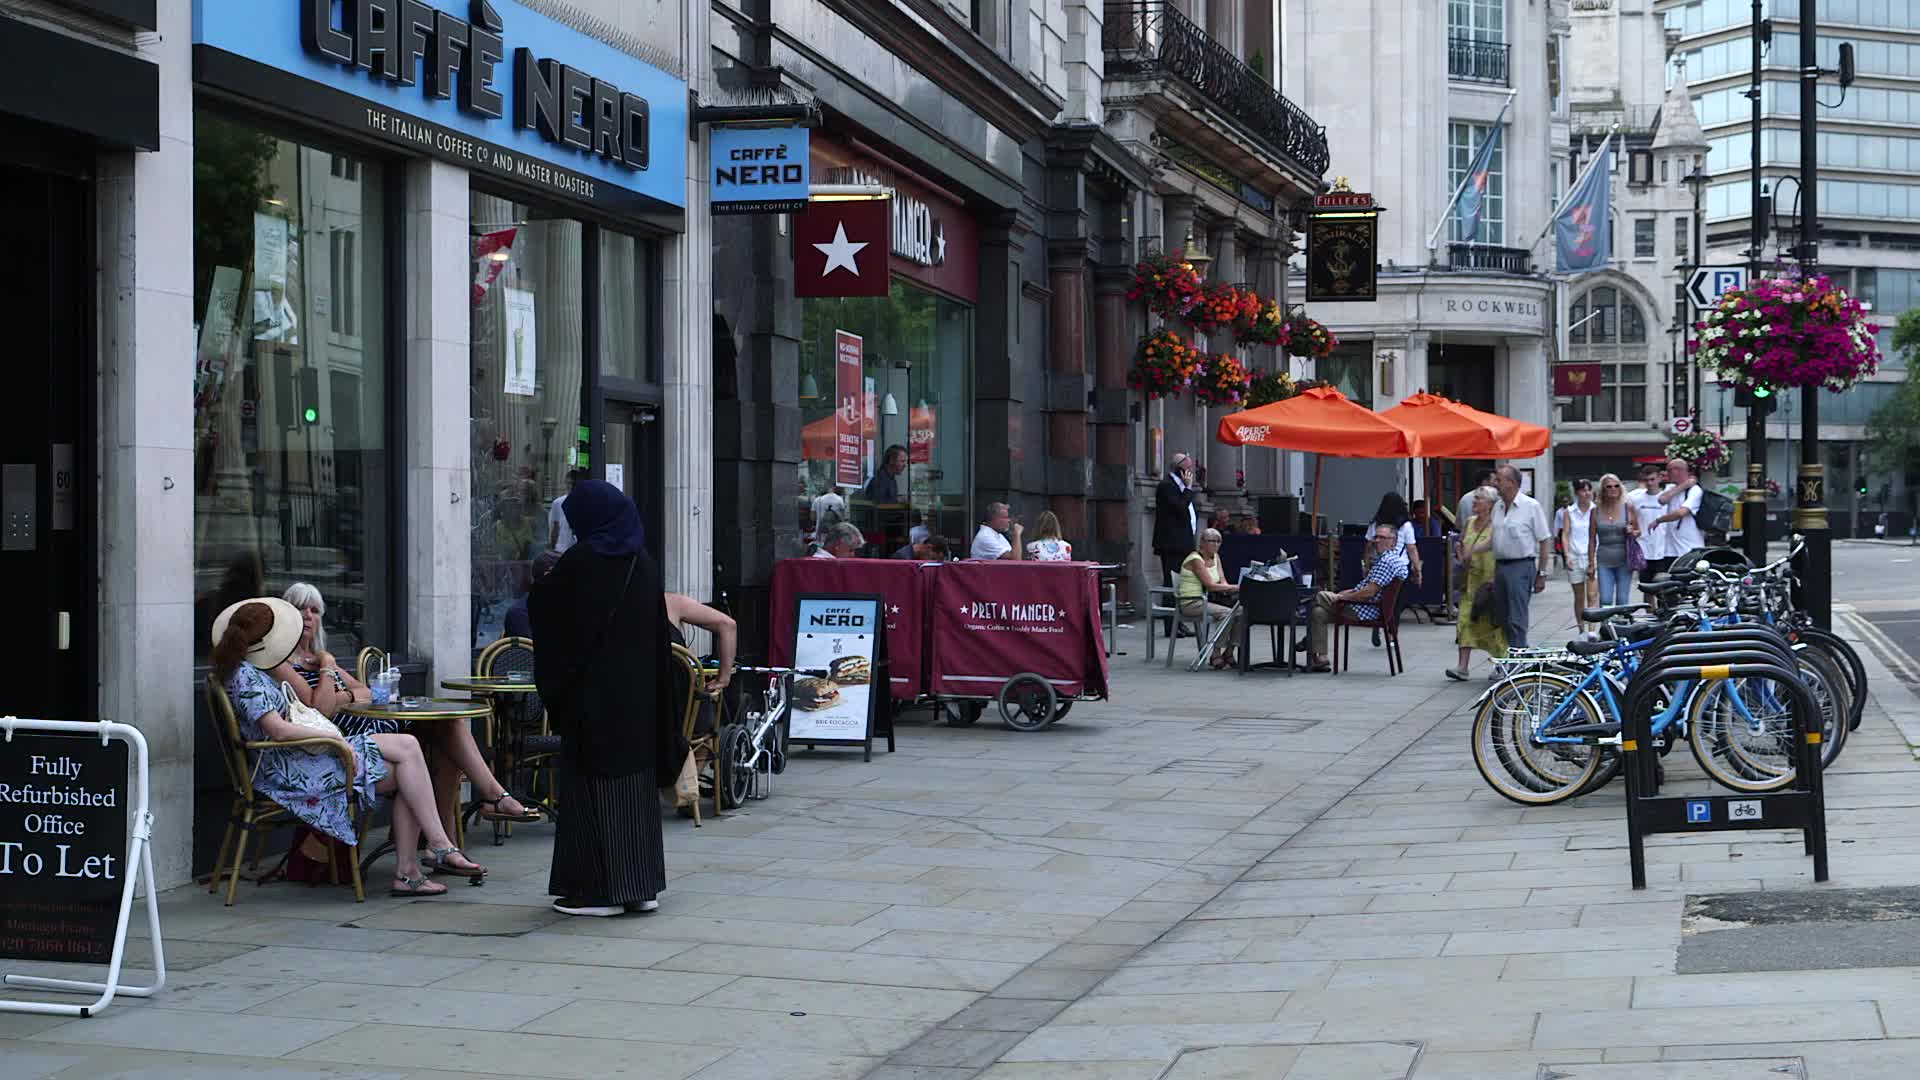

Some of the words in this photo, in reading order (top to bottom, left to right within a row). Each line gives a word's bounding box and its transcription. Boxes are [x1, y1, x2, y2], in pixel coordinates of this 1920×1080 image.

[514, 47, 649, 171] NERO
[367, 109, 387, 130] THE
[391, 117, 433, 145] ITALIAN
[437, 132, 473, 159] COFFEE
[493, 153, 513, 171] AND
[517, 161, 551, 184] MASTER
[554, 171, 594, 198] ROASTERS
[716, 165, 802, 186] NERO
[716, 203, 729, 211] THE
[732, 203, 760, 211] ITALIAN
[763, 202, 790, 210] COFFEE
[892, 187, 932, 266] MANGER
[1720, 273, 1736, 296] P
[1447, 299, 1537, 316] ROCKWELL
[1236, 425, 1271, 436] APEROL
[57, 471, 71, 489] 60
[810, 614, 864, 627] NERO
[971, 601, 998, 619] PRET
[1000, 603, 1008, 620] A
[1011, 603, 1056, 622] MANGER
[30, 755, 83, 780] Fully
[0, 783, 116, 807] Refurbished
[1693, 803, 1706, 820] P
[24, 813, 85, 835] Office
[0, 841, 43, 876] To
[55, 844, 116, 879] Let
